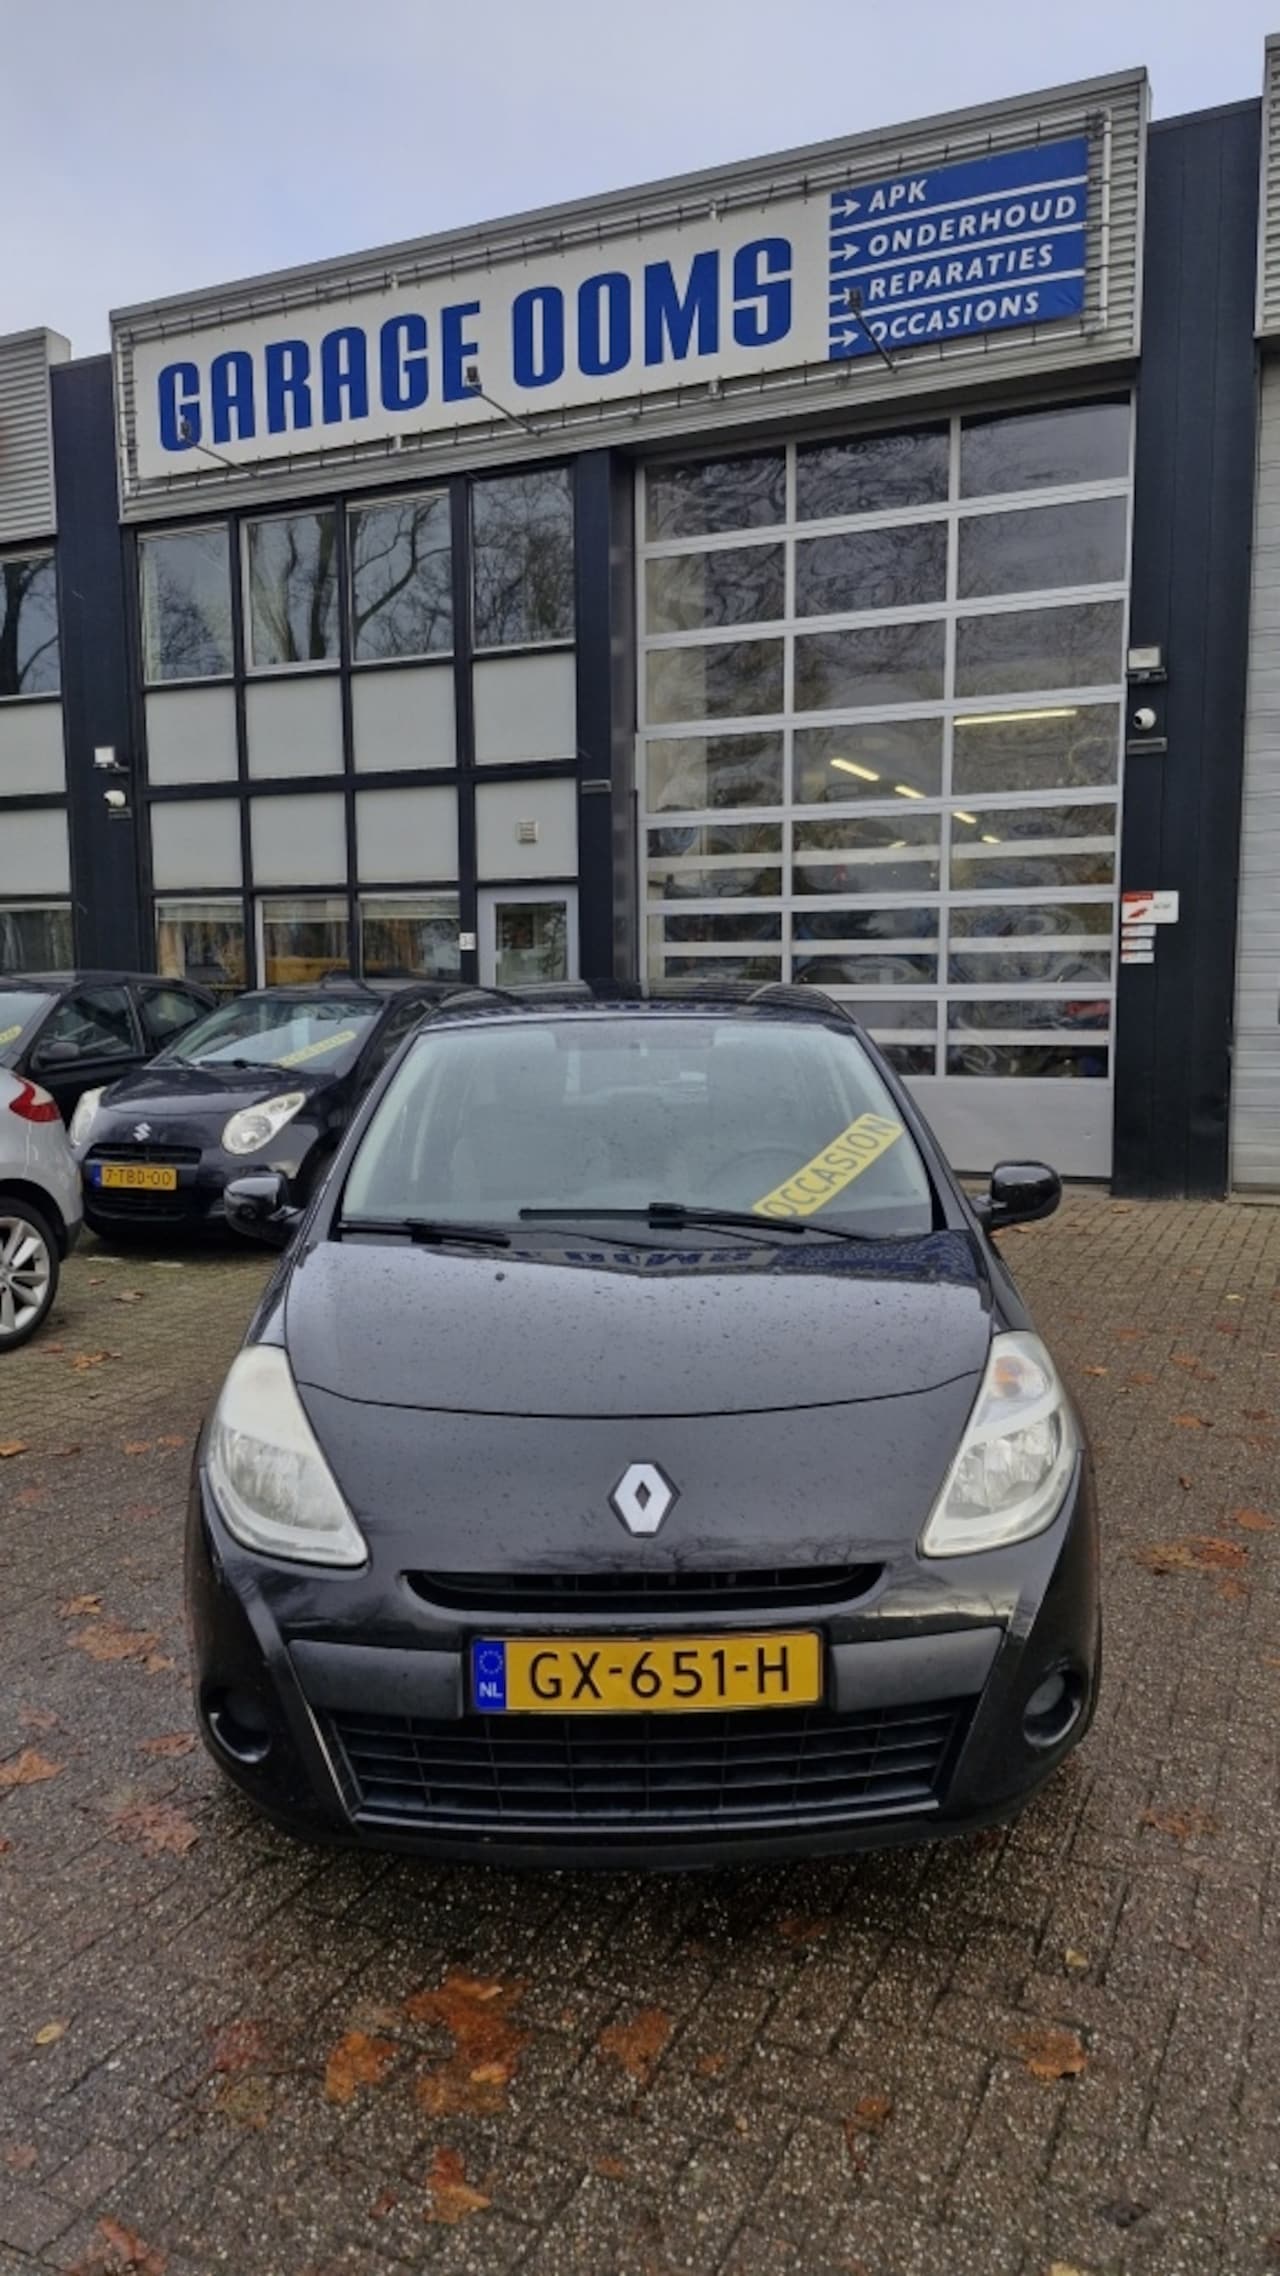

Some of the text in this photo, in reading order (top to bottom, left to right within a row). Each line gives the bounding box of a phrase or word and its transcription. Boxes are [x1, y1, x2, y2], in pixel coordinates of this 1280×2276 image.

[868, 179, 927, 212] APK
[868, 196, 1076, 257] ONDERHOUD
[868, 244, 1053, 301] REPARATIES
[158, 237, 792, 451] GARAGE OOMS
[868, 291, 1040, 342] OCCASIONS
[762, 1116, 899, 1216] OCCASION
[479, 1681, 503, 1698] NL
[529, 1646, 789, 1699] GX-651-H
